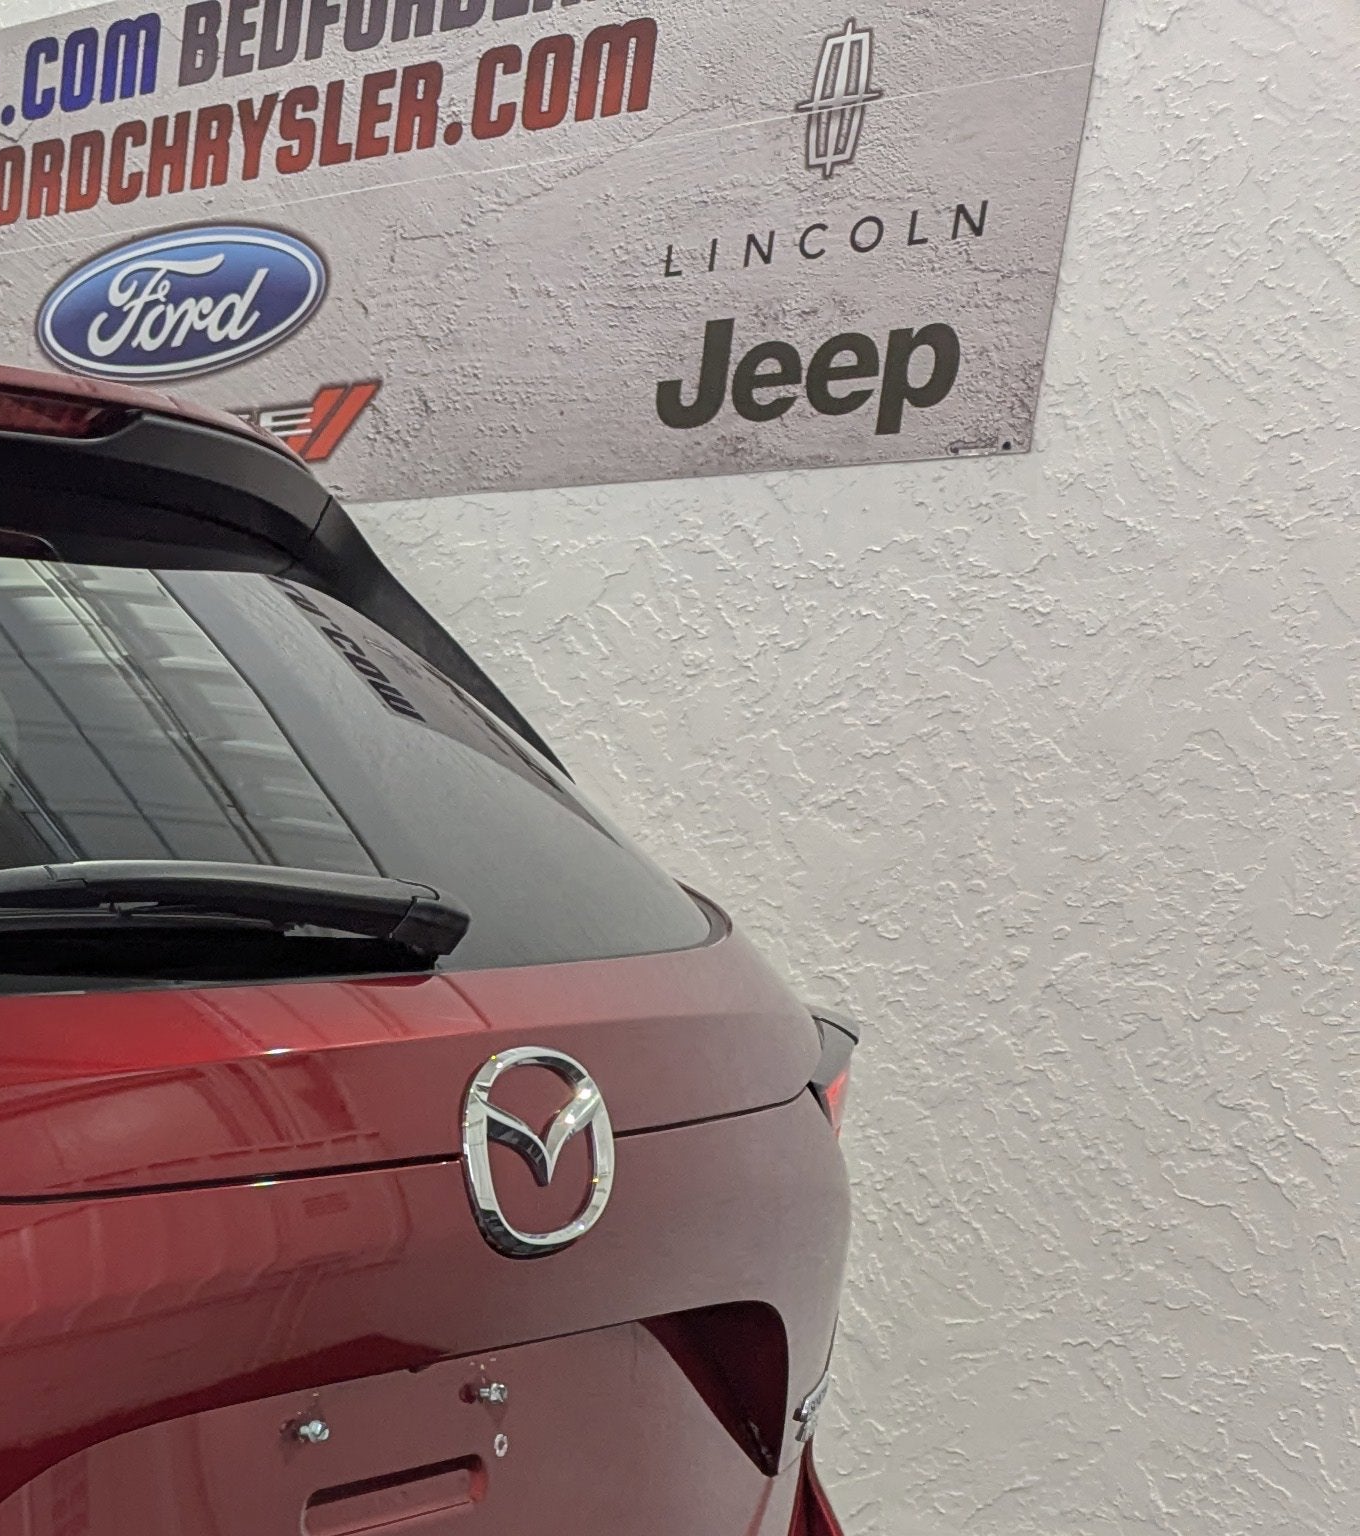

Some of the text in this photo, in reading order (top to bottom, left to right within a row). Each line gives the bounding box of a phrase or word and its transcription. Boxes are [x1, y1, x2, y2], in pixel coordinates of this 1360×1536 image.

[663, 200, 989, 278] LINCOLN
[86, 252, 270, 358] Ford
[656, 317, 961, 436] Jeep
